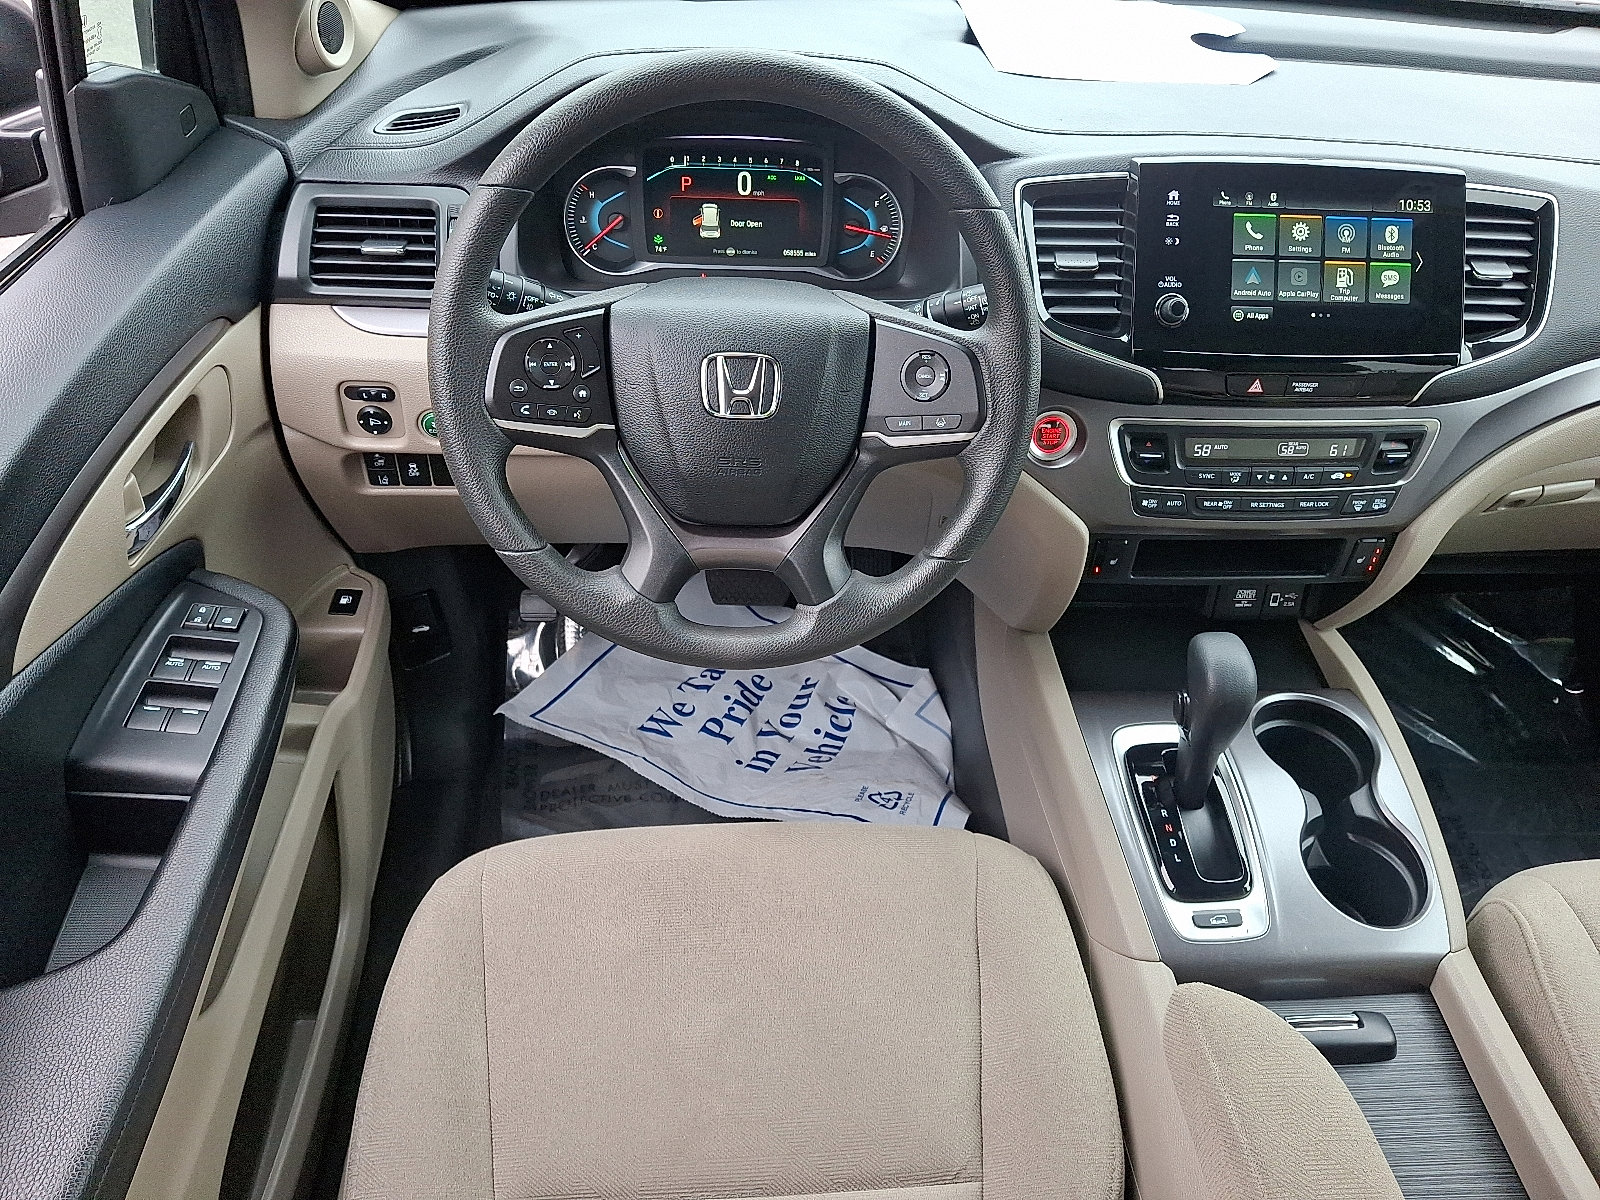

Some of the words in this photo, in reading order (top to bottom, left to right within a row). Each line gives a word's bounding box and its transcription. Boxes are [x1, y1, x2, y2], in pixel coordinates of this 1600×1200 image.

[681, 176, 692, 191] P
[737, 171, 752, 196] 0
[589, 191, 595, 199] H
[874, 200, 880, 208] F
[1399, 200, 1431, 211] 10:53
[746, 220, 763, 228] Open
[870, 250, 875, 258] E
[1383, 274, 1398, 282] SMS
[1278, 290, 1296, 298] Apple
[1296, 290, 1319, 299] CarPlay
[1339, 287, 1351, 295] Trip
[1375, 292, 1405, 300] Messages
[1255, 312, 1269, 320] Apps
[1194, 444, 1211, 457] 58
[1281, 445, 1294, 455] 58
[1329, 444, 1348, 457] 61
[698, 673, 774, 746] Pride
[756, 676, 820, 743] Your
[637, 701, 697, 739] We
[735, 749, 782, 774] in
[854, 785, 869, 803] PLEASE
[899, 792, 915, 816] RECYCLE
[1161, 809, 1169, 818] R
[1165, 824, 1173, 832] N
[1169, 838, 1177, 847] D
[1174, 854, 1181, 862] L
